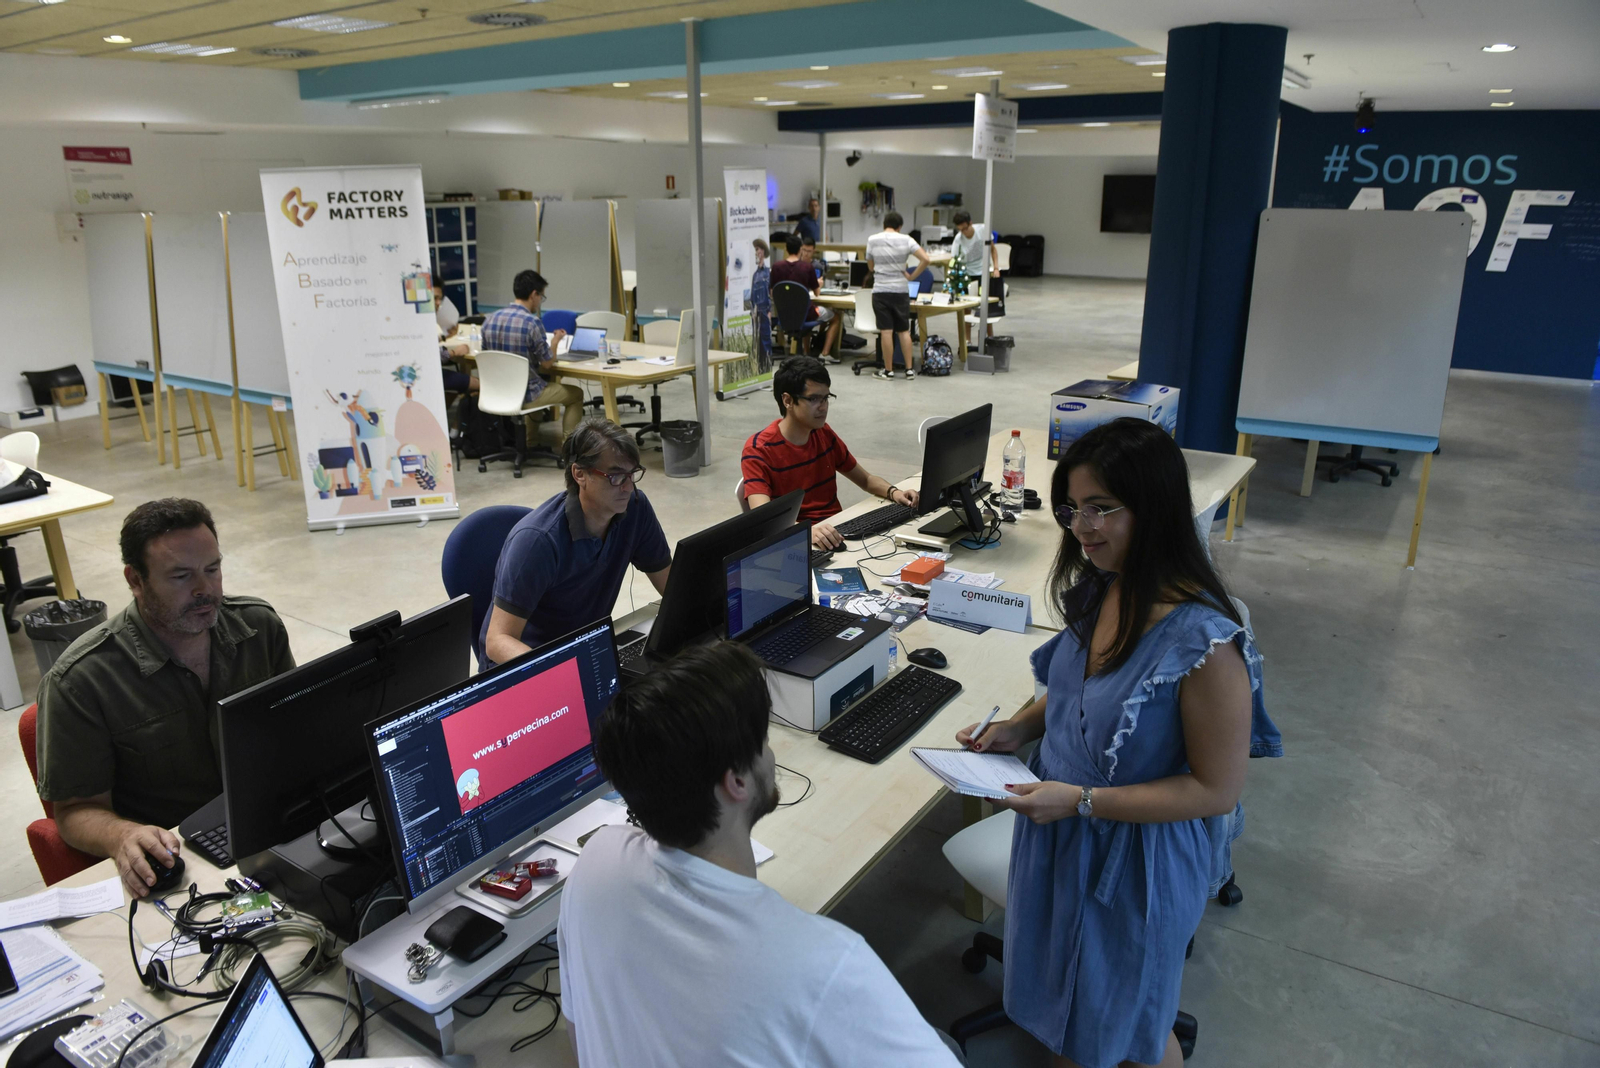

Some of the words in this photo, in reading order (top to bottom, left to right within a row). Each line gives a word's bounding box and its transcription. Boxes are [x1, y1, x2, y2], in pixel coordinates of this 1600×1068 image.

[1323, 144, 1518, 185] #Somos
[327, 190, 404, 204] FACTORY
[329, 206, 408, 220] MATTERS
[1348, 187, 1575, 272] OF
[283, 252, 367, 268] Aprendizaje
[298, 273, 352, 288] Basado
[354, 278, 367, 286] en
[314, 294, 378, 308] Factorías
[1060, 402, 1084, 410] SAMSUNG
[961, 589, 1024, 608] comunitaria
[473, 705, 569, 760] www.supervecina.com
